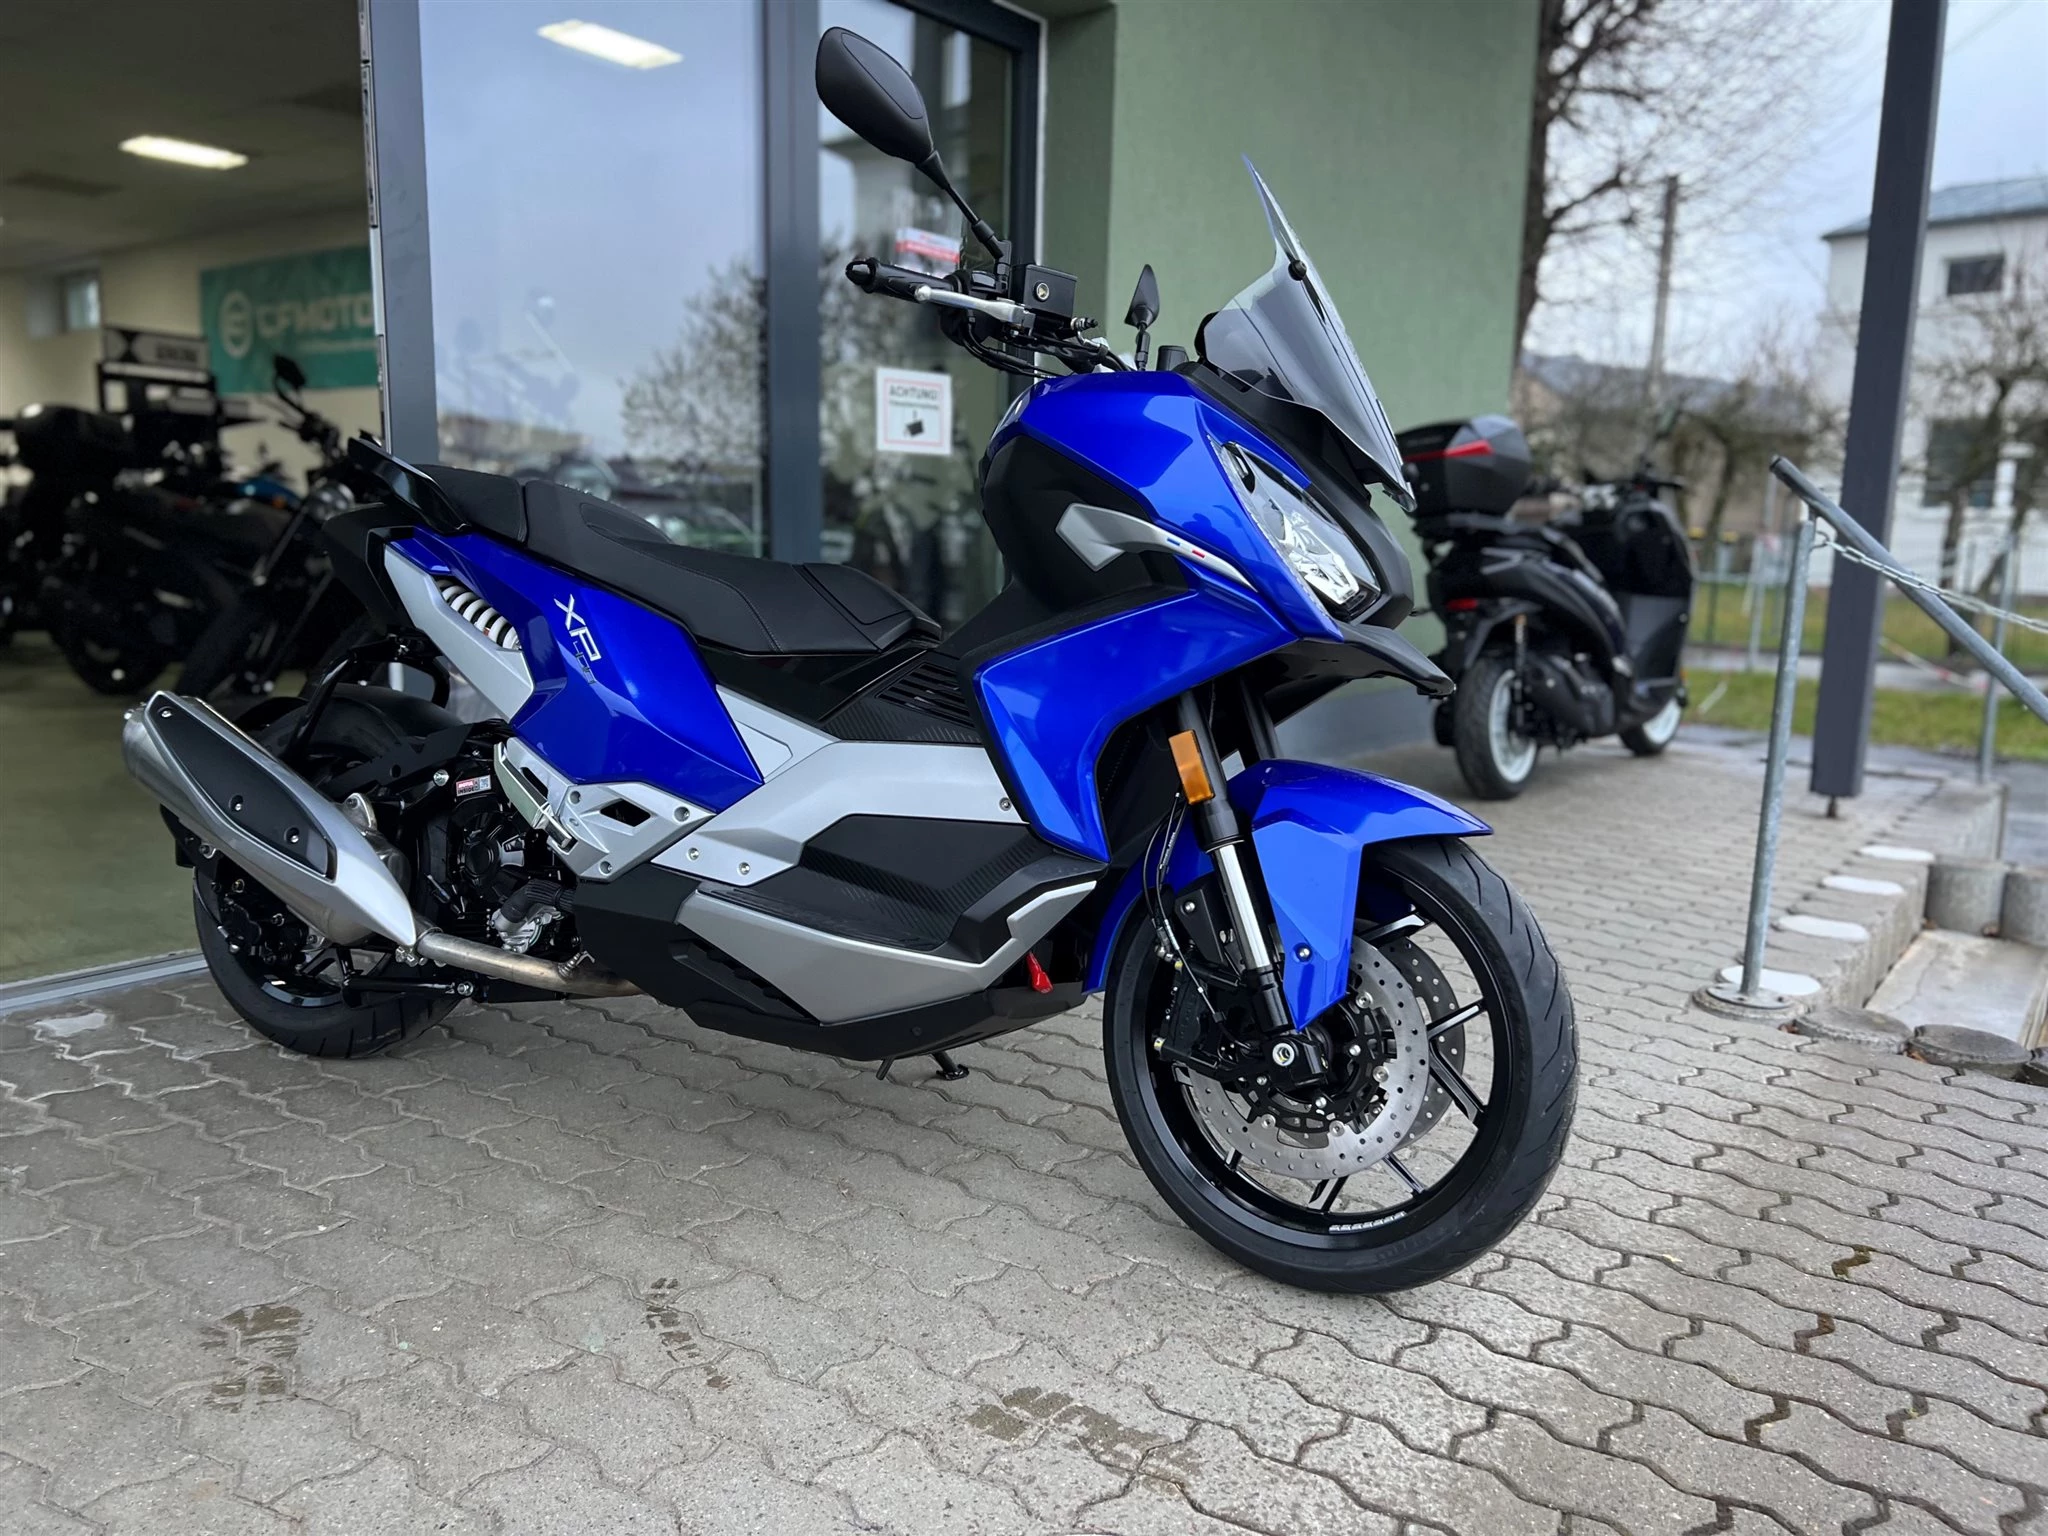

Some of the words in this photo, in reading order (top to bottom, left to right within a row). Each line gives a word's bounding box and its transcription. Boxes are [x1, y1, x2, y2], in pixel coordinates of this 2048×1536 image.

[256, 294, 373, 337] CFMOTO
[553, 593, 602, 662] XP
[572, 640, 598, 684] 400
